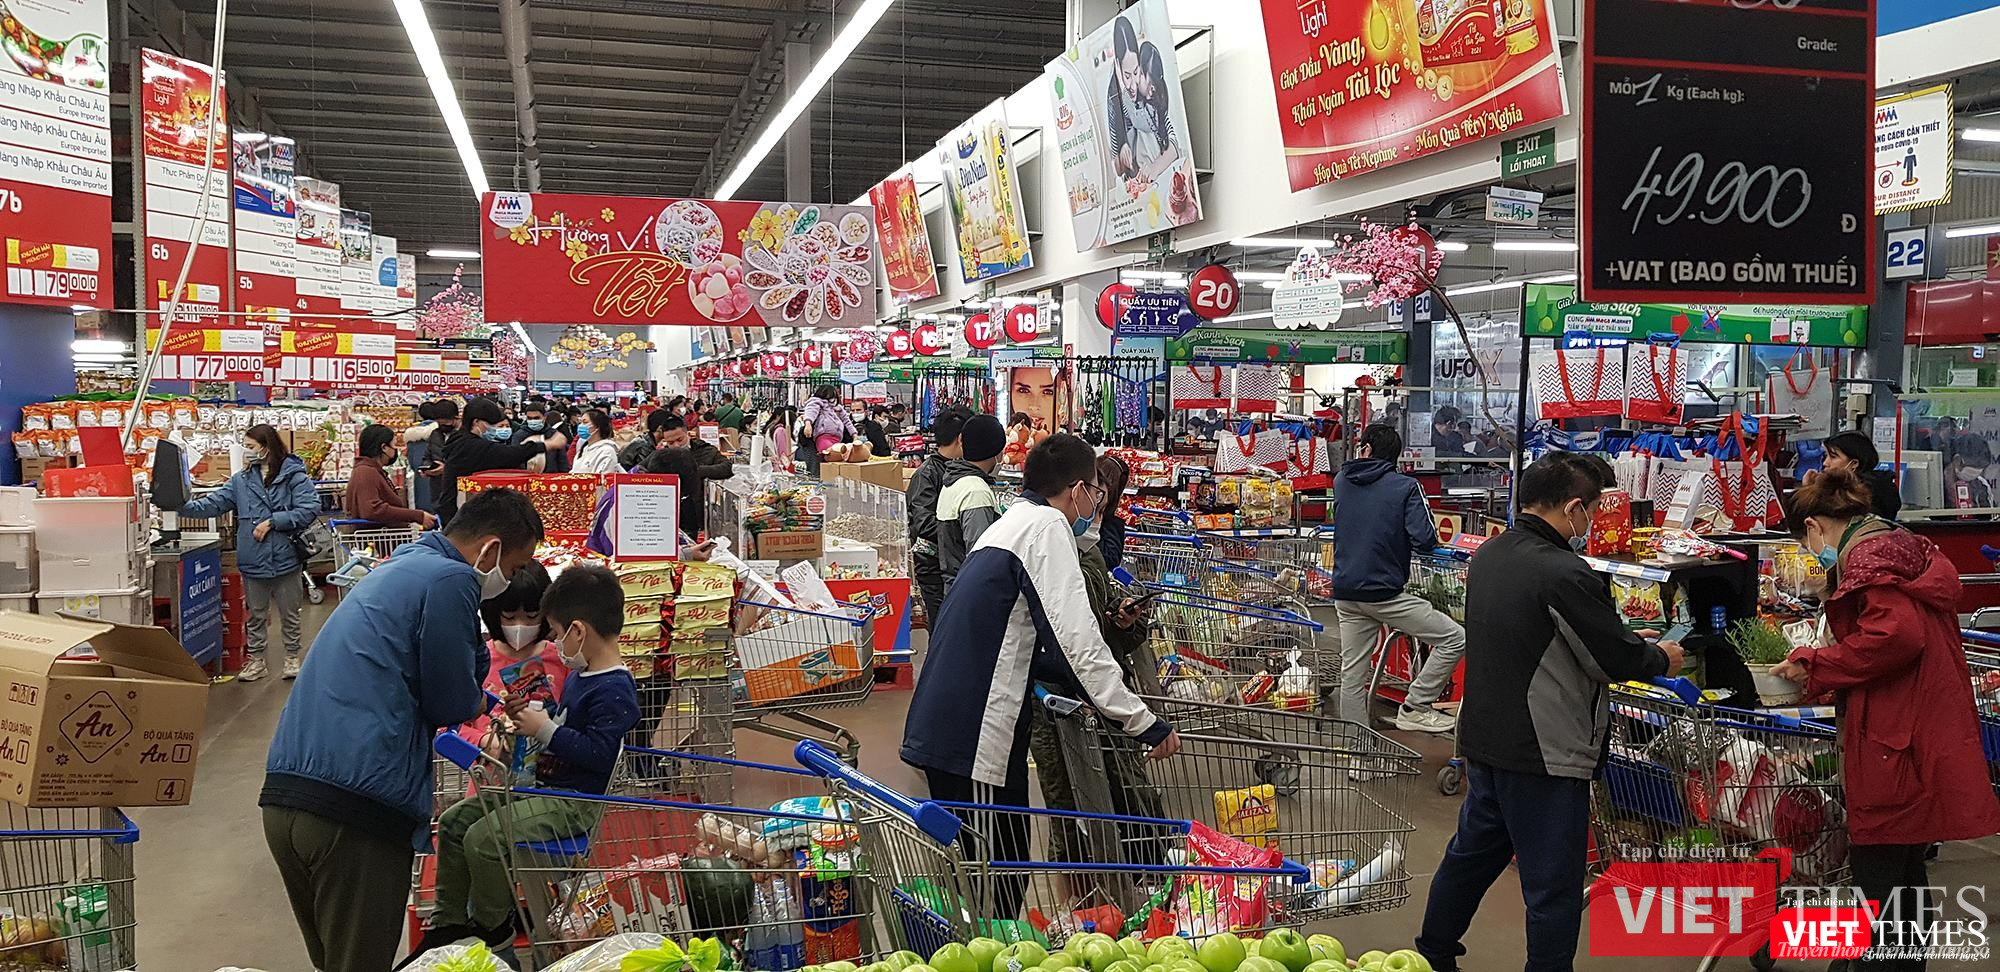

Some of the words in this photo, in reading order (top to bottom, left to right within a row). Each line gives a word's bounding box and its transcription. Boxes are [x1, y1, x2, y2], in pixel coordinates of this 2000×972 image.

[1300, 1, 1328, 37] Light
[1797, 37, 1838, 51] Grade:
[1299, 56, 1321, 81] Dầu
[1318, 89, 1345, 116] Ngàn
[1345, 67, 1371, 102] Tài
[1374, 60, 1400, 99] Lộc
[1635, 73, 1662, 106] 1
[1667, 85, 1684, 100] Kg
[1687, 86, 1720, 100] (Each
[1723, 88, 1745, 104] kg):
[58, 105, 79, 117] Europe
[80, 110, 106, 123] Imported
[60, 140, 81, 152] Europe
[82, 145, 107, 156] Imported
[1361, 145, 1398, 170] Neptune
[1415, 130, 1439, 152] Món
[1439, 124, 1461, 149] Quà
[1516, 135, 1541, 155] EXIT
[1894, 137, 1919, 149] COVID-19
[61, 176, 82, 187] Europe
[82, 179, 107, 191] Imported
[1621, 146, 1812, 234] 49.900
[1887, 187, 1921, 199] DISTANCE
[0, 188, 23, 213] 7b
[1841, 213, 1857, 233] Đ
[528, 212, 611, 256] Hương
[616, 215, 654, 251] Vị
[151, 243, 170, 261] 6b
[1887, 238, 1925, 268] 22
[1604, 260, 1664, 281] +VAT
[1670, 260, 1726, 283] (BAO
[1733, 252, 1786, 284] GỒM
[1791, 255, 1857, 287] THUẾ)
[239, 276, 253, 290] 5b
[569, 250, 686, 318] Tết
[296, 298, 308, 310] 4b
[1196, 279, 1233, 310] 20
[973, 322, 990, 341] 17
[1016, 313, 1036, 334] 18
[168, 338, 199, 350] PROMOTION
[303, 341, 332, 353] PROMOTION
[892, 336, 909, 351] 15
[921, 330, 938, 347] 16
[1197, 330, 1222, 341] Xanh
[1223, 334, 1246, 347] Sạch
[1440, 357, 1477, 379] UFO
[75, 710, 117, 740] An
[139, 743, 169, 765] An
[163, 781, 175, 799] 4
